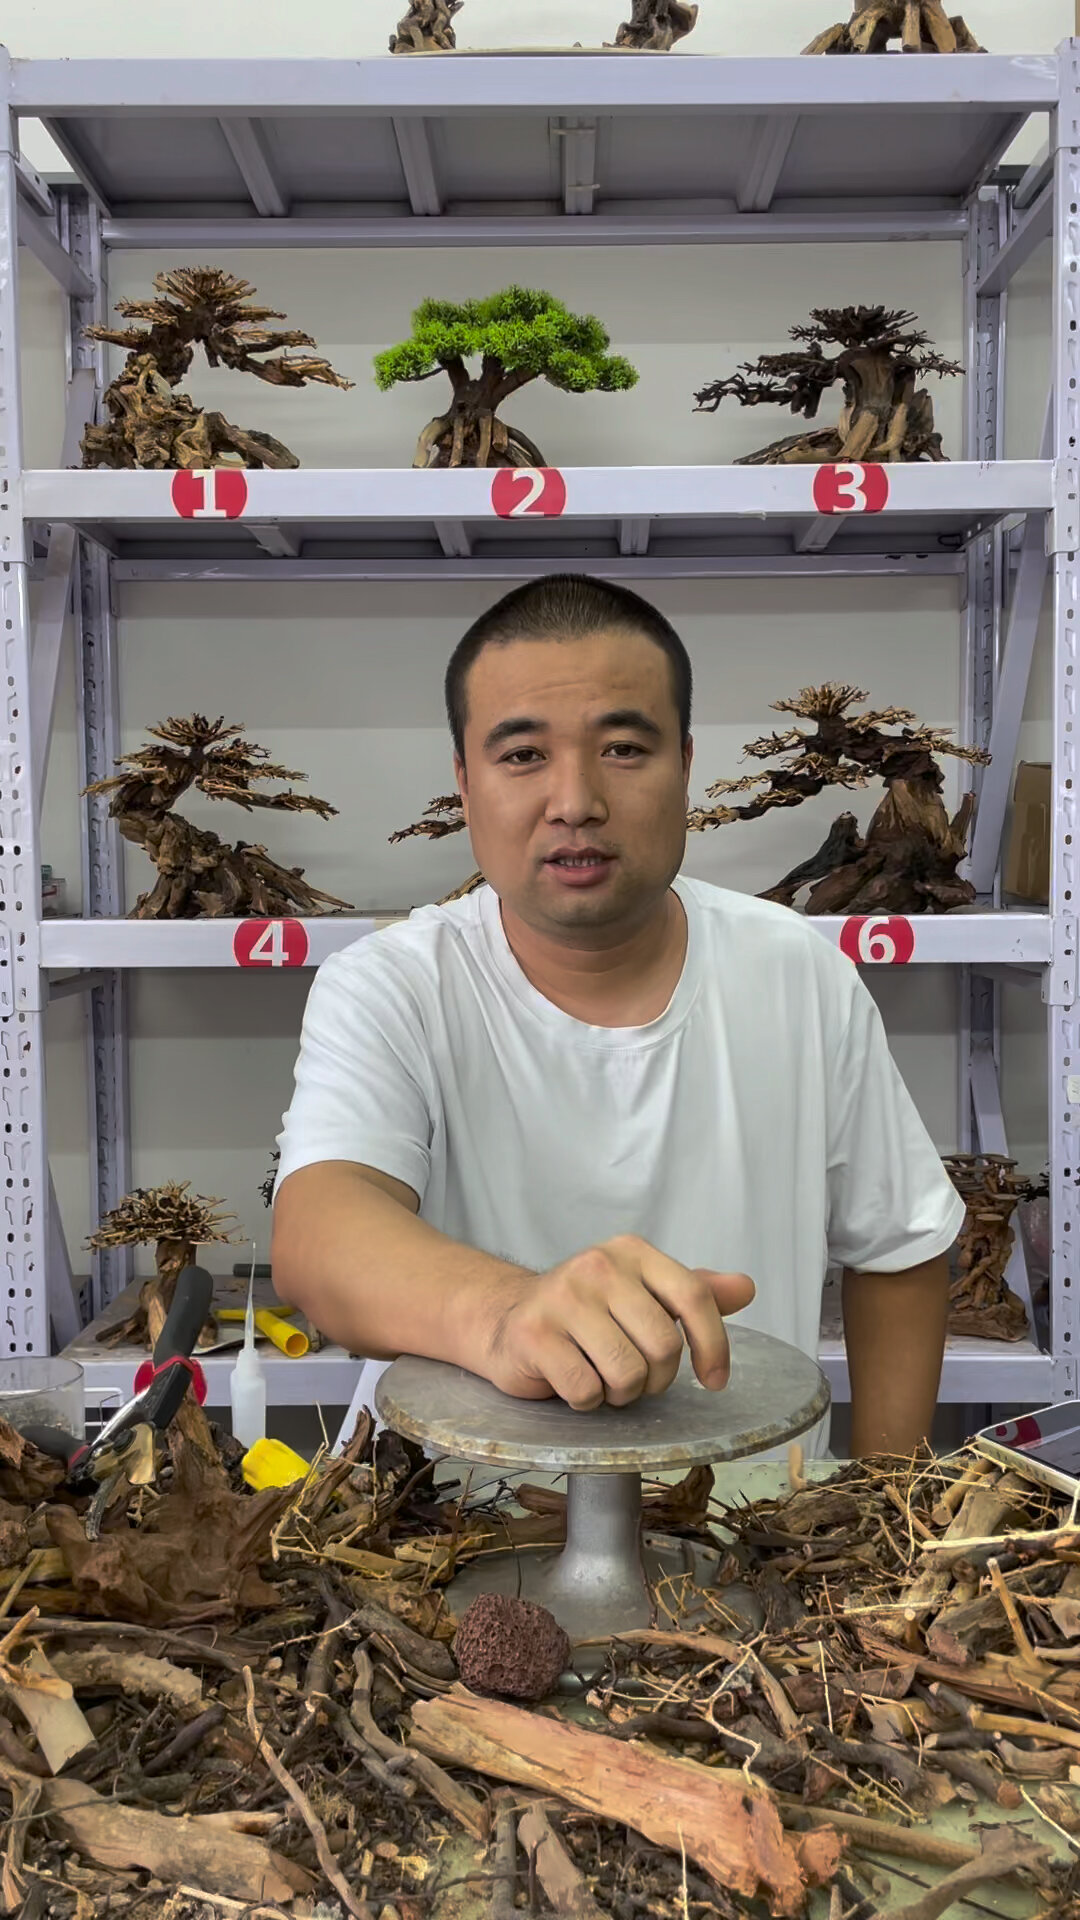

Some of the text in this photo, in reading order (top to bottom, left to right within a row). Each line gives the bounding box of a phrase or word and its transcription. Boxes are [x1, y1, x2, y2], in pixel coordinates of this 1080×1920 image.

[190, 469, 228, 518] 1
[509, 468, 547, 516] 2
[832, 464, 867, 513] 3
[250, 920, 288, 966] 4
[857, 917, 896, 963] 6
